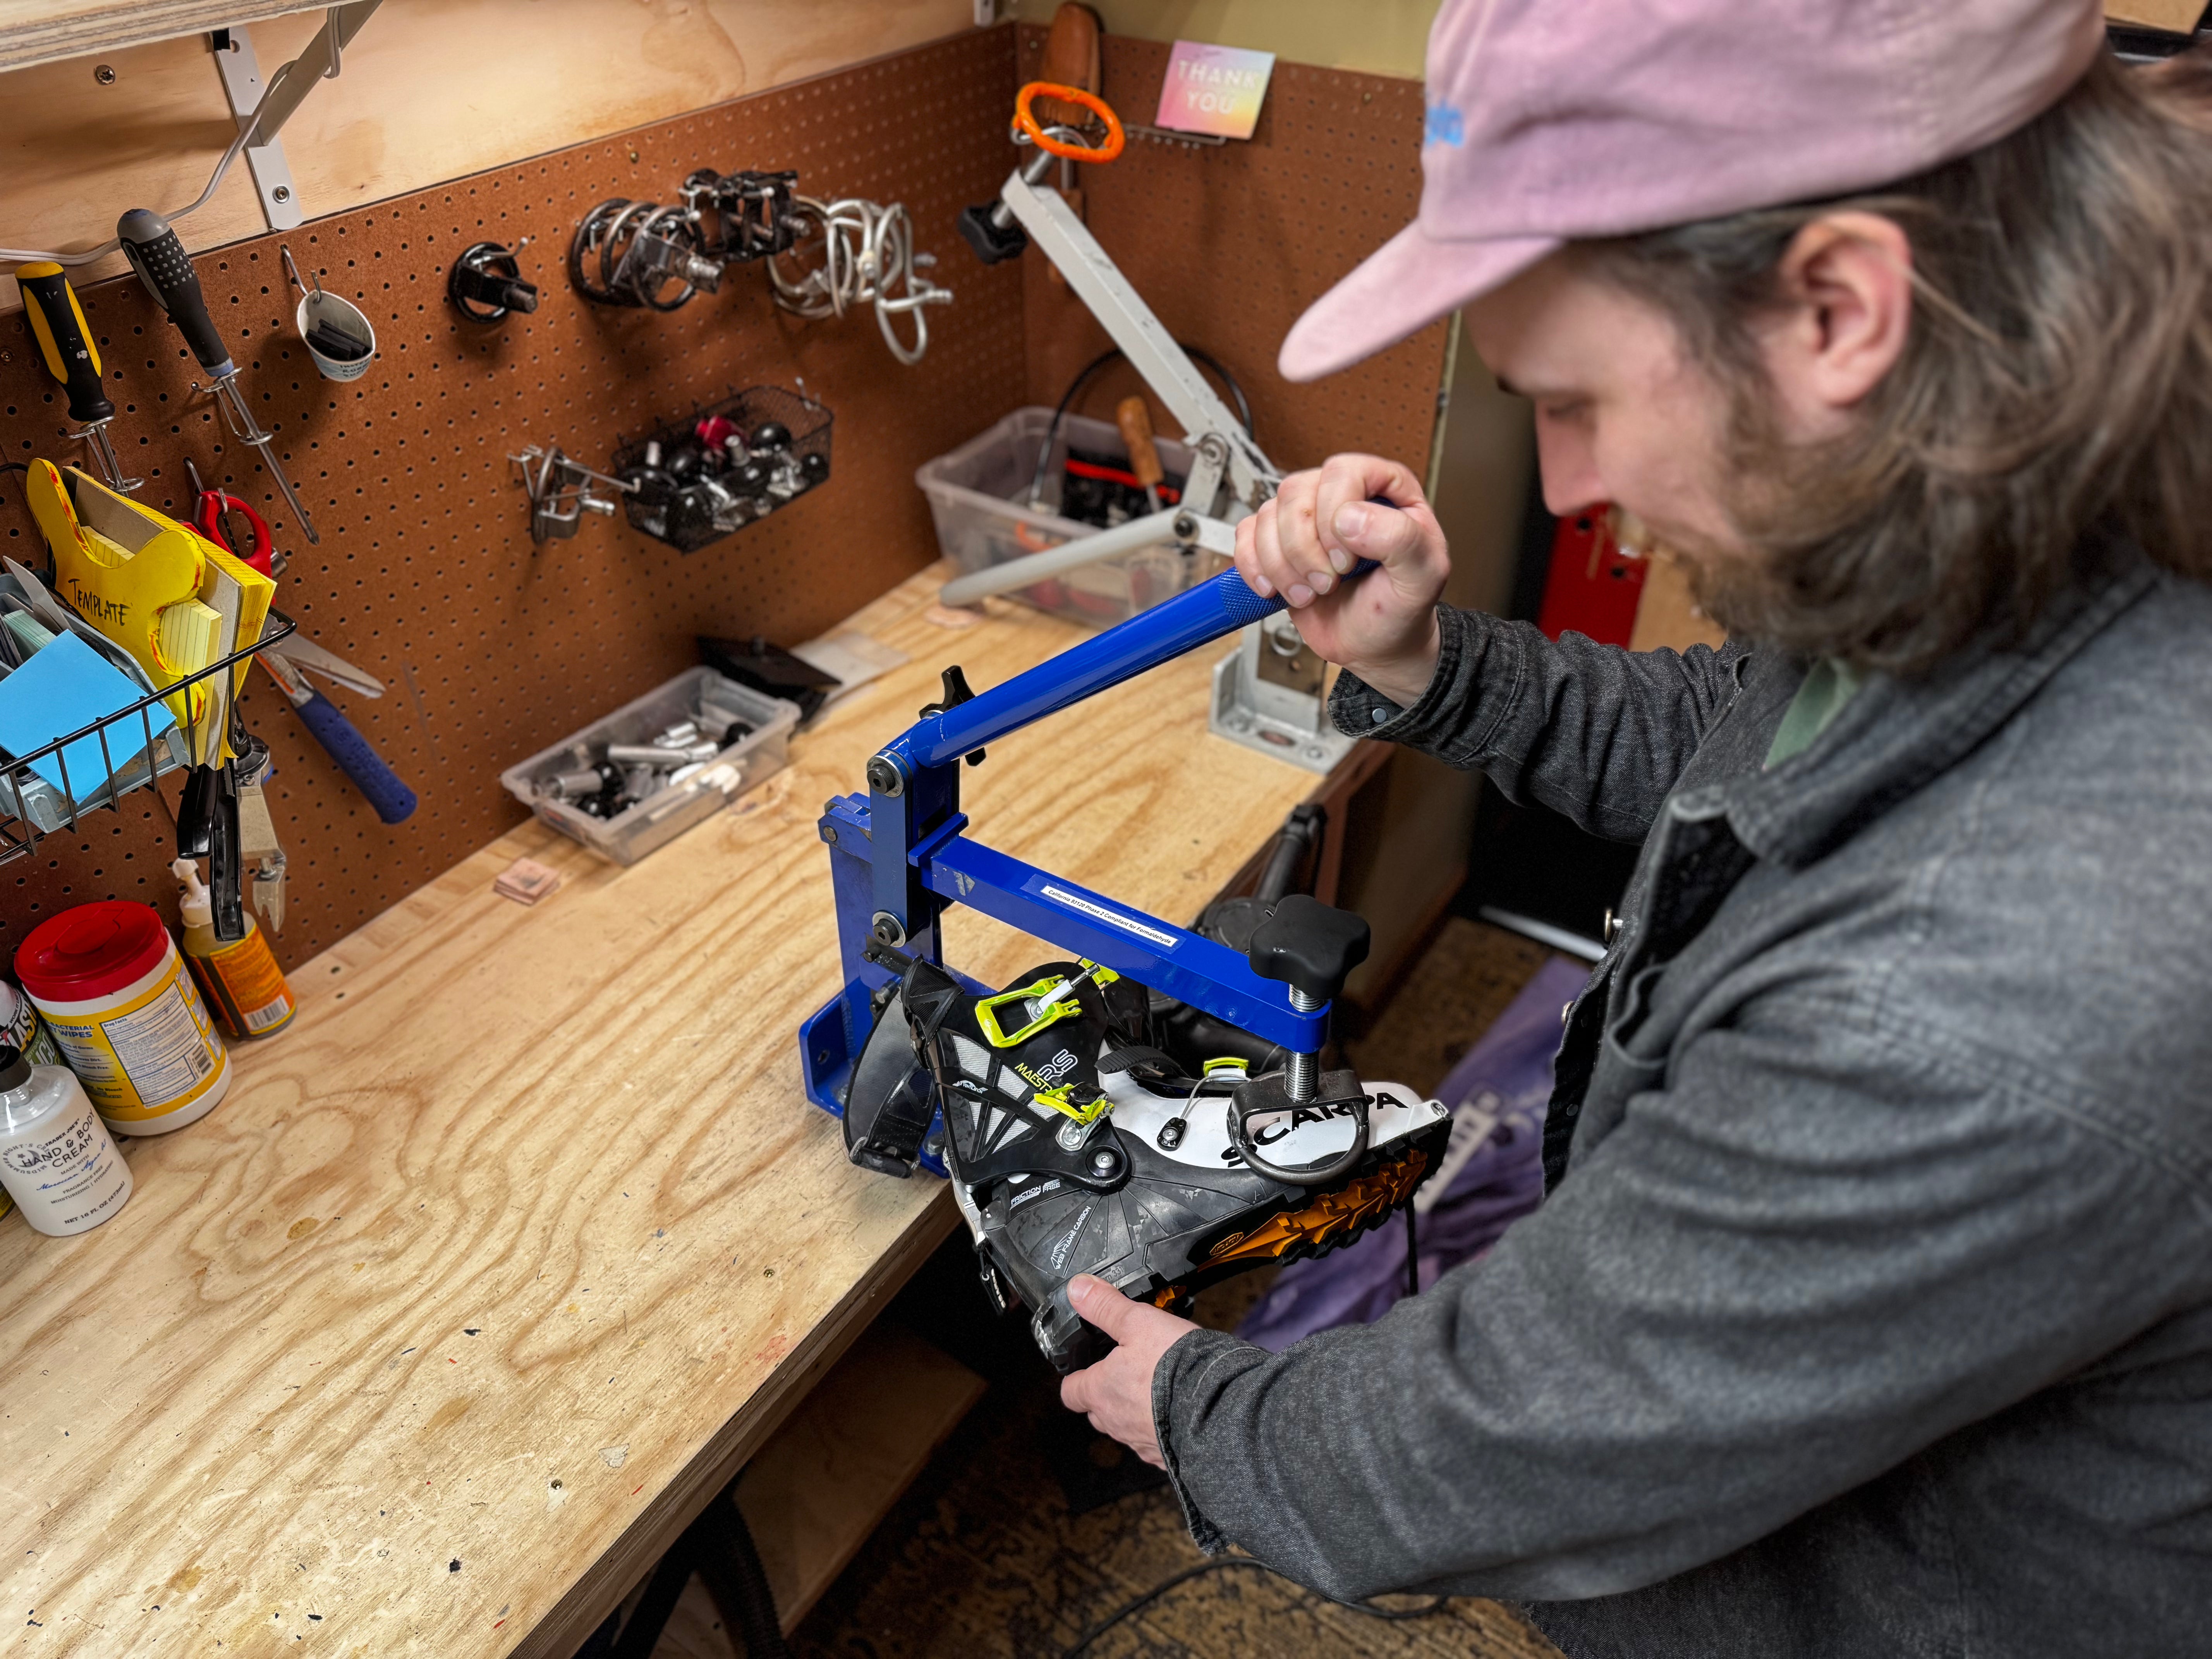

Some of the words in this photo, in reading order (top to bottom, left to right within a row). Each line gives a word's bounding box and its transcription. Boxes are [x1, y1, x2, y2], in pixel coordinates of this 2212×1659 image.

[1177, 60, 1257, 88] THANK
[1186, 90, 1237, 115] YOU
[68, 578, 131, 626] TEMPLATE
[1048, 890, 1070, 902] California
[1071, 899, 1085, 907] 93120
[1085, 905, 1100, 914] Phase
[1104, 913, 1128, 926] Compliant
[1136, 927, 1171, 944] Formaldehyde
[58, 1029, 93, 1037] WIPES
[1037, 1049, 1078, 1081] RS
[22, 1147, 62, 1168] HAND
[66, 1139, 74, 1148] &
[76, 1108, 95, 1139] BODY
[45, 1132, 66, 1146] TRADER
[52, 1133, 93, 1168] CREAM
[60, 1164, 77, 1175] MADE
[77, 1154, 89, 1166] WITH
[62, 1174, 94, 1194] FRAGRANCE
[93, 1164, 104, 1176] FREE
[51, 1185, 90, 1204] MOISTURIZING
[94, 1160, 113, 1183] HYDRATING
[1011, 1185, 1041, 1205] FRICTION
[1043, 1182, 1061, 1193] FREE
[99, 1200, 108, 1209] OZ
[1056, 1253, 1065, 1269] WEB
[1062, 1230, 1077, 1252] FRAME
[1074, 1206, 1091, 1230] CARBON
[1112, 1266, 1124, 1277] 331
